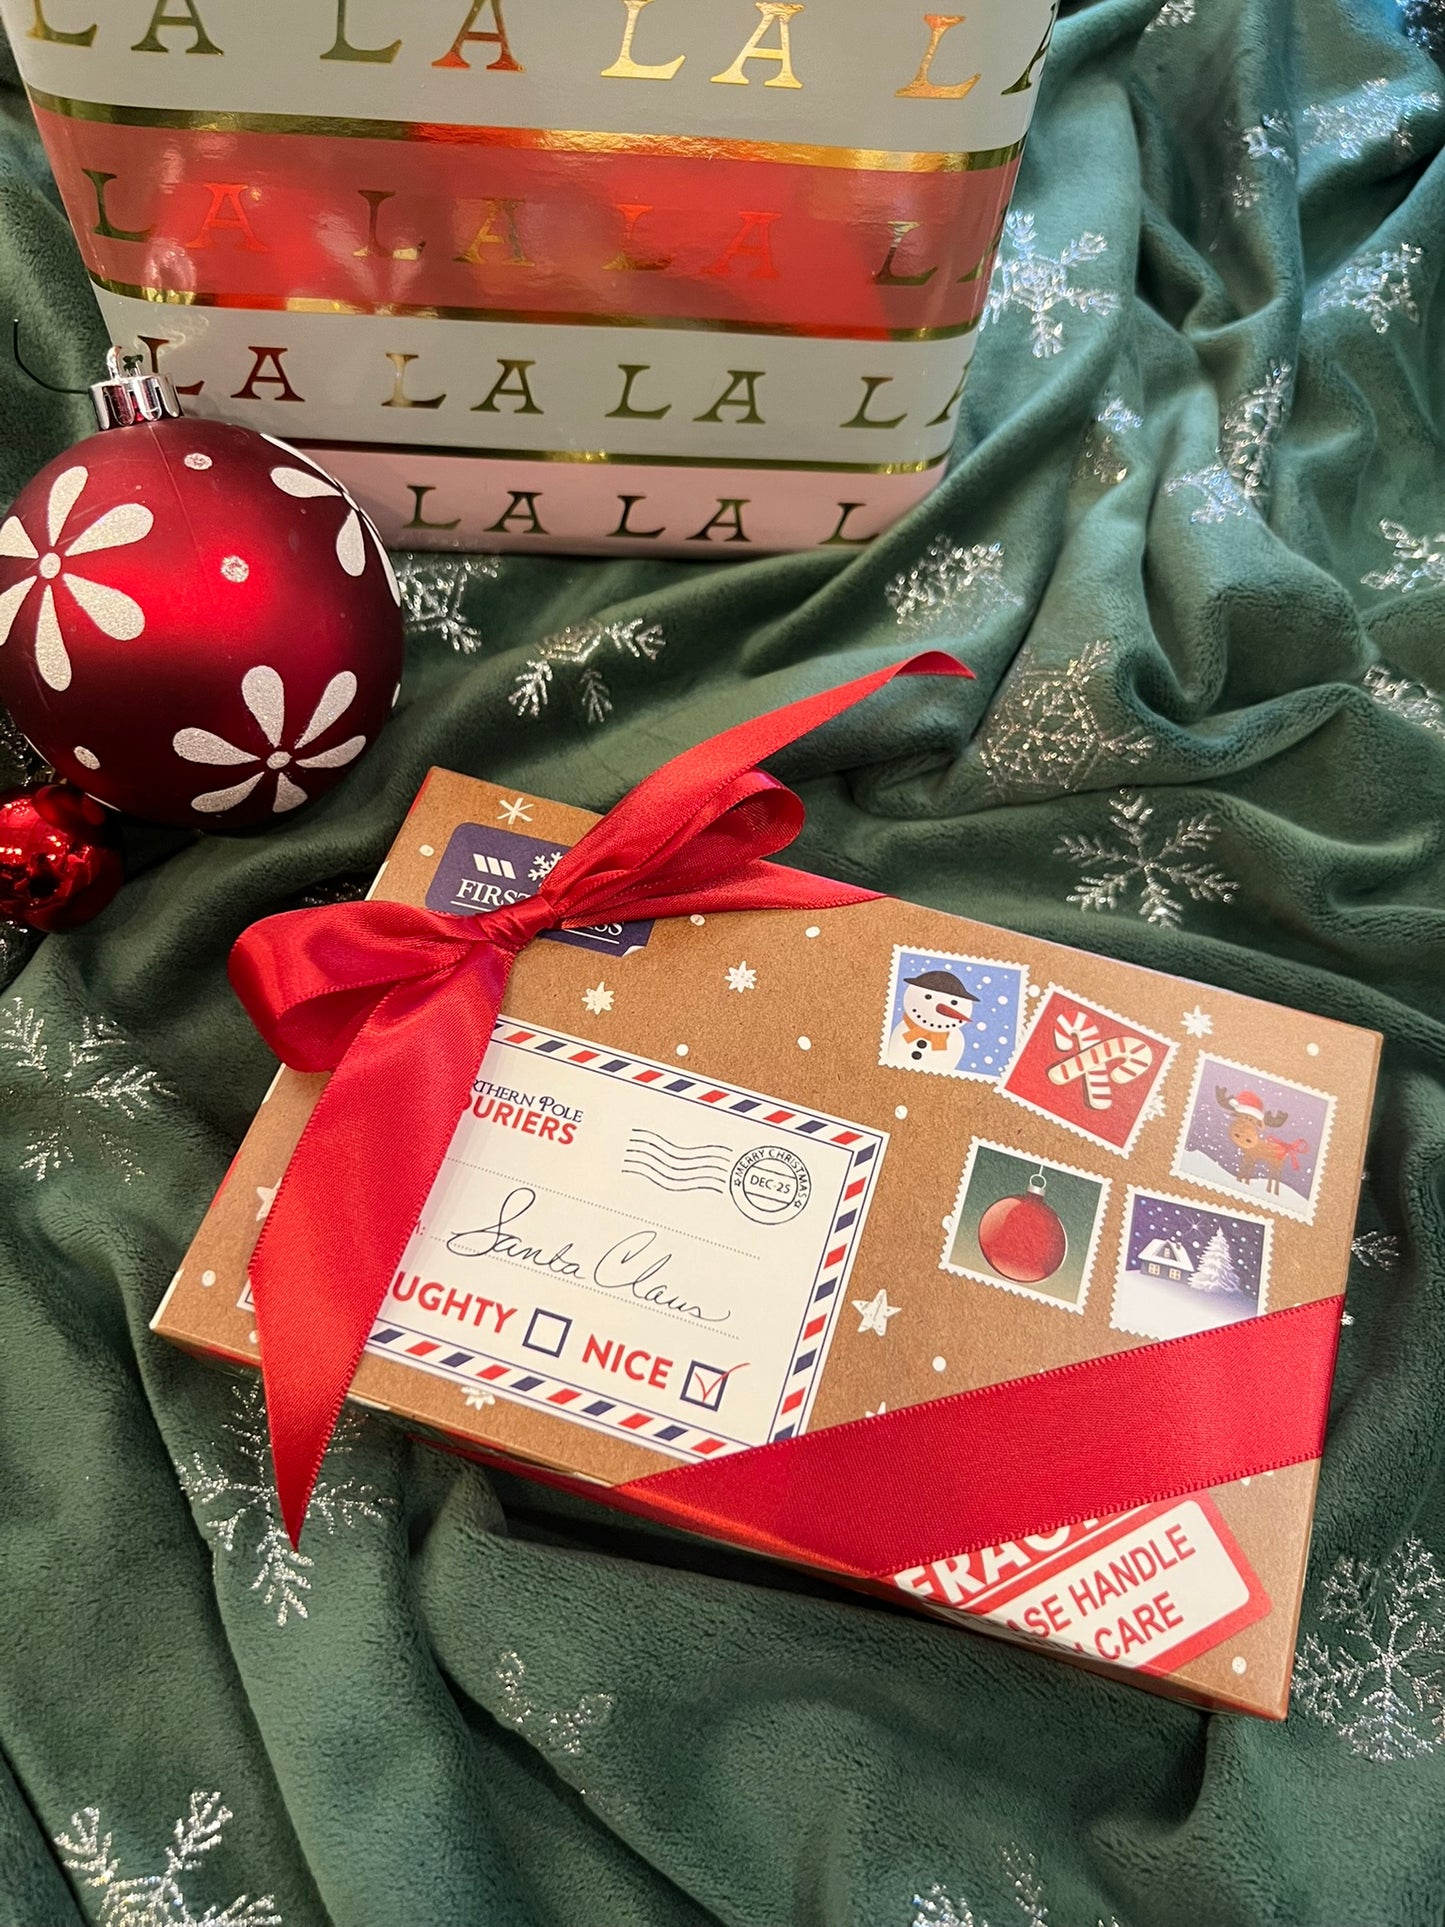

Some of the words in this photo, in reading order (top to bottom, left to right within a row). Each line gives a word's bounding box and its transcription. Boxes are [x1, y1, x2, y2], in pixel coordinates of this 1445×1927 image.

[601, 0, 803, 88] LA
[82, 168, 268, 252] LA
[353, 190, 536, 267] LA
[602, 204, 782, 279] LA
[382, 353, 544, 414] LA
[605, 364, 766, 424] LA
[403, 485, 549, 535] LA
[606, 494, 750, 542] LA
[463, 1093, 578, 1145] URIERS
[734, 1149, 766, 1178] MERRY
[768, 1148, 809, 1199] CHRISTMAS
[749, 1174, 792, 1195] DEC-25
[446, 1187, 587, 1281] Santa
[594, 1230, 731, 1322] Claus
[581, 1333, 675, 1390] NICE
[1067, 1523, 1196, 1617] HANDLE
[1093, 1590, 1185, 1661] CARE
